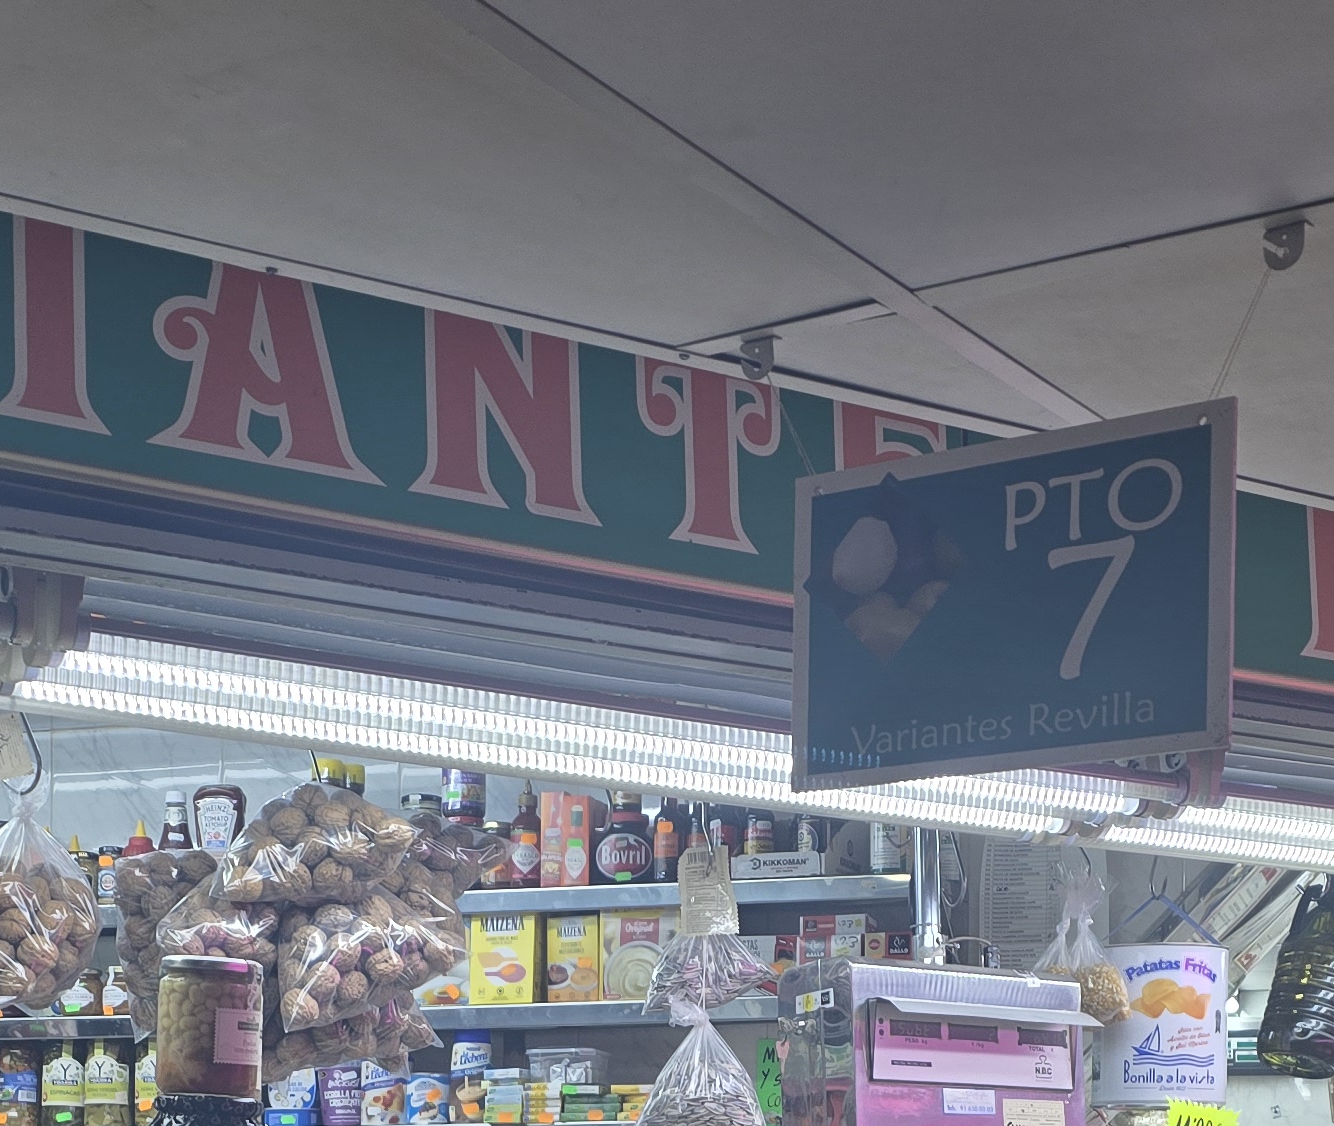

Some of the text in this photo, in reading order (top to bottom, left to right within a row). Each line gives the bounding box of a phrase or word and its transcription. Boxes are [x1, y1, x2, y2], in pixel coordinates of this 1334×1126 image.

[1003, 458, 1183, 551] PTO
[1047, 535, 1135, 680] 7
[851, 691, 1156, 757] Variantes Revilla
[204, 815, 229, 823] TOMATO
[205, 804, 228, 814] HEINZ
[600, 843, 646, 867] Bovril
[763, 858, 807, 867] KIKKOMAN
[479, 914, 525, 932] MAIZENA
[556, 925, 588, 939] MAIZENA
[1125, 955, 1218, 984] Patatas Fritas
[1124, 1060, 1215, 1085] Bonilla a la vista
